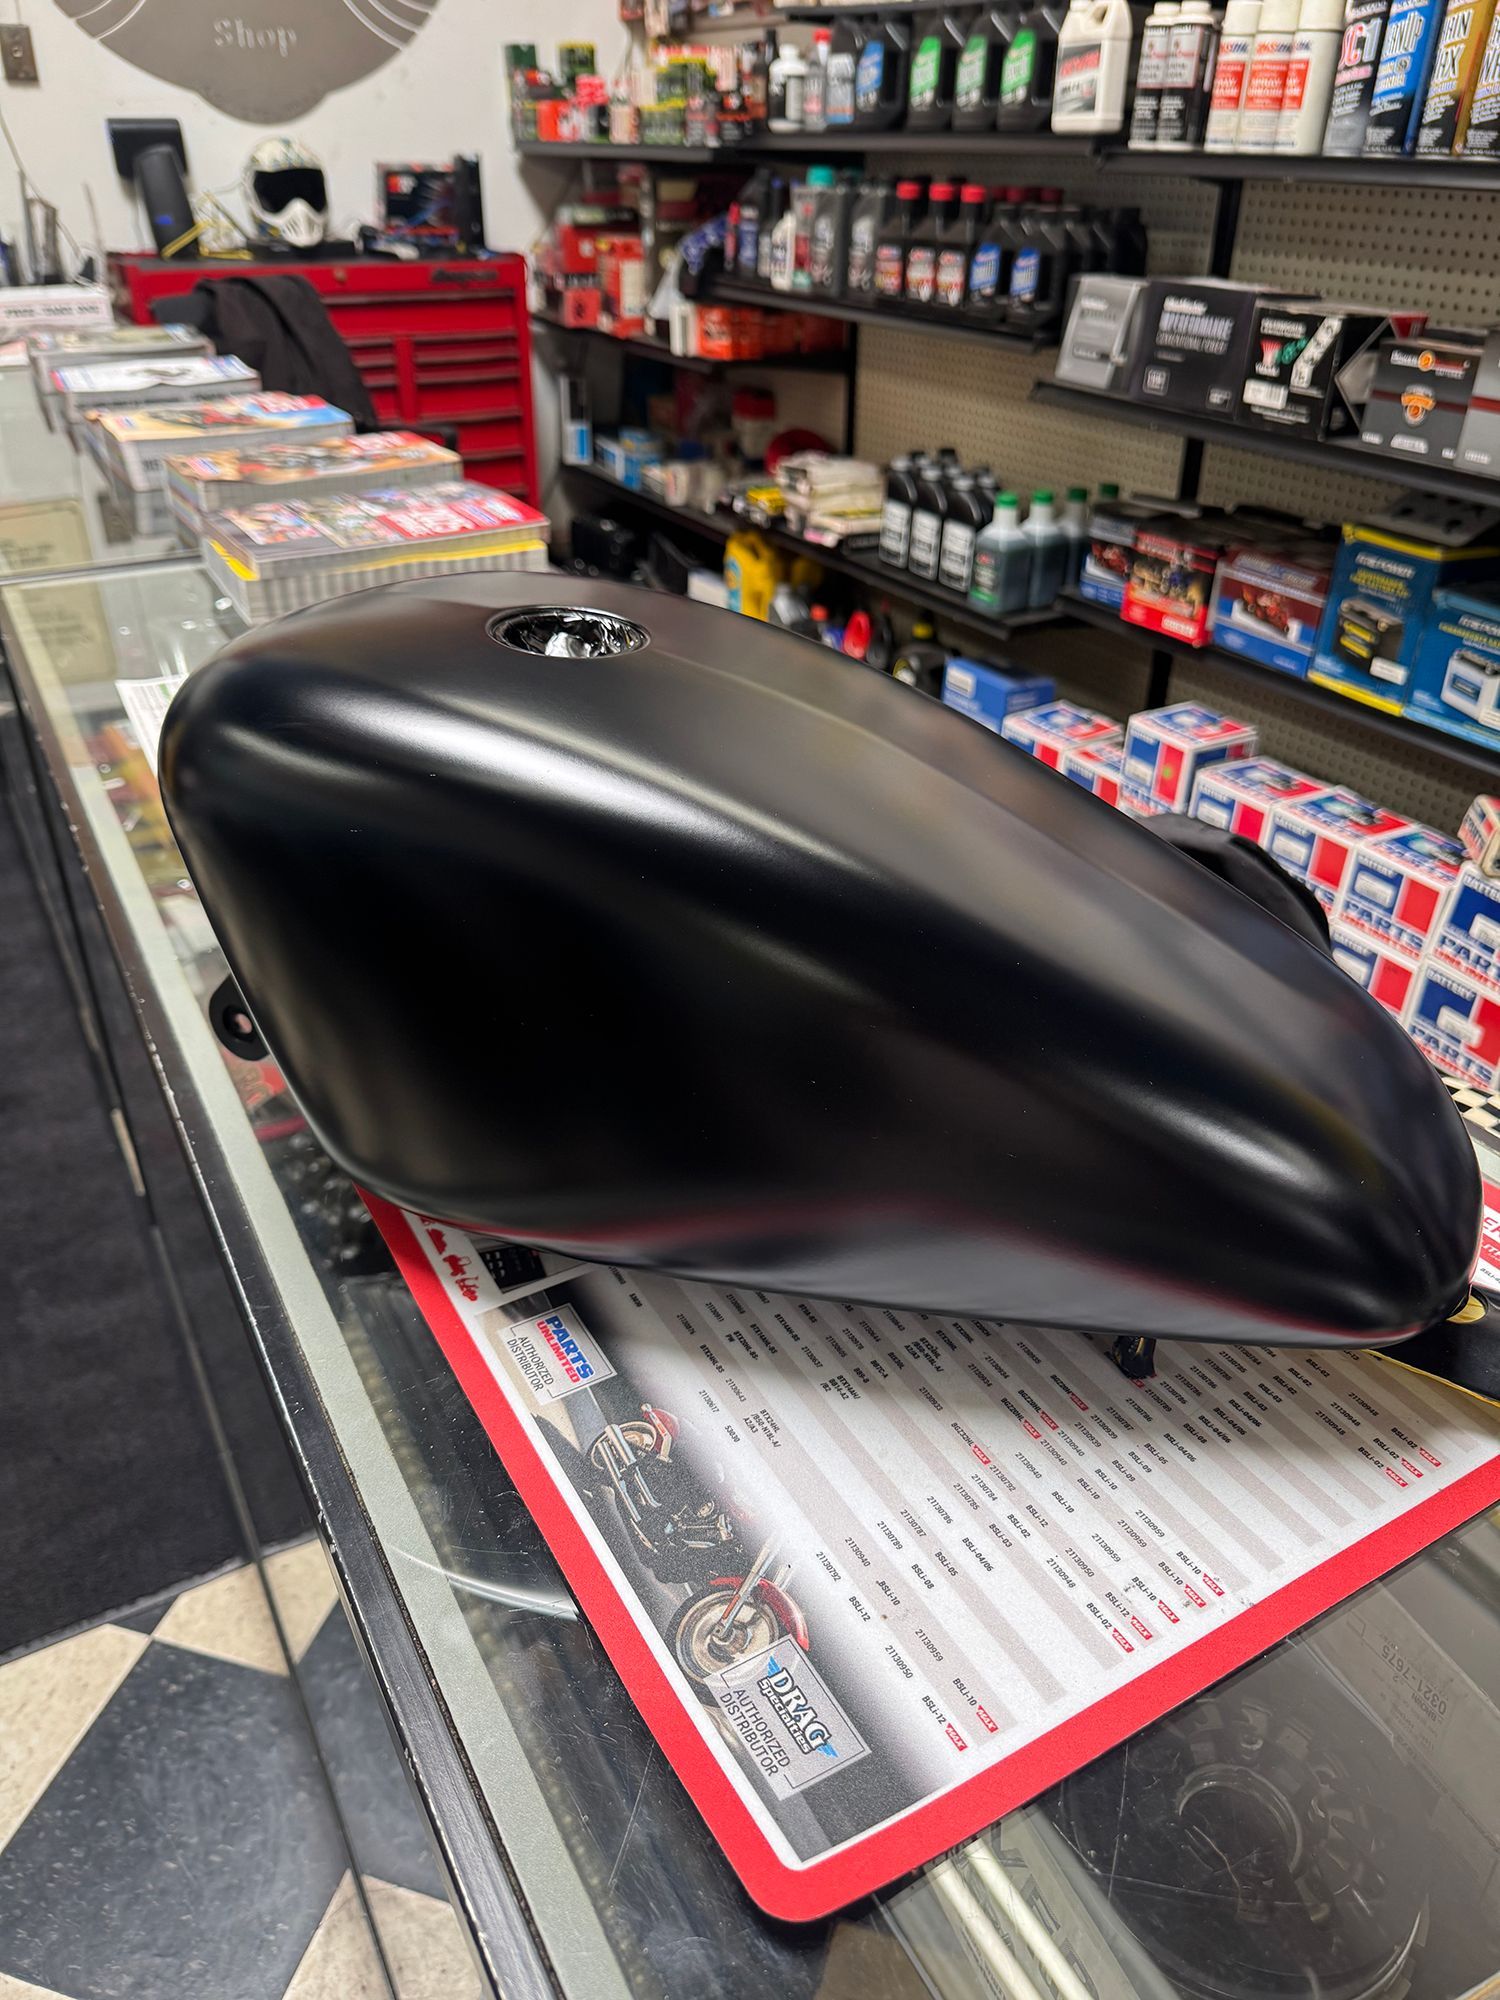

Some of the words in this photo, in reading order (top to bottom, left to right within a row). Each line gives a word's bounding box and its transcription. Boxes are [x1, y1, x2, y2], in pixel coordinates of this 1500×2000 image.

[213, 16, 298, 58] Shop
[1343, 901, 1424, 950] PARTS
[1426, 969, 1477, 1001] BATTERY
[1408, 1025, 1494, 1081] PARTS
[518, 1336, 555, 1386] AUTHORIZED
[536, 1320, 581, 1384] UNLIMITED
[544, 1315, 595, 1380] PARTS
[506, 1338, 546, 1393] DISTRIBUTOR
[1288, 1368, 1312, 1387] BSLi-02
[1258, 1383, 1283, 1403] BSLi-03
[1272, 1375, 1298, 1396] BSLi-02
[1001, 1398, 1024, 1422] BGZ20HL
[1229, 1399, 1262, 1428] BSLi-04/06
[1243, 1391, 1269, 1411] BSLi-03
[760, 1409, 780, 1433] BTX24HL
[1090, 1414, 1118, 1439] 21130939
[1106, 1407, 1135, 1430] 21130787
[1198, 1415, 1231, 1444] BSLi-04/06
[1213, 1407, 1247, 1438] BSLi-04/06
[725, 1425, 740, 1443] 53030
[951, 1423, 973, 1447] BGZ32HL
[1057, 1430, 1085, 1456] 21130940
[1074, 1422, 1102, 1448] 21130939
[1183, 1423, 1208, 1444] BSLi-08
[1391, 1427, 1417, 1449] BSLi-02
[1040, 1439, 1067, 1465] 21130940
[1144, 1443, 1168, 1465] BSLi-05
[1163, 1433, 1197, 1463] BSLi-04/06
[1358, 1446, 1384, 1469] BSLi-02
[1373, 1437, 1399, 1459] BSLi-02
[1015, 1452, 1042, 1479] 21130940
[1112, 1460, 1136, 1483] BSLi-09
[1128, 1451, 1152, 1473] BSLi-09
[972, 1474, 998, 1501] 21130784
[989, 1465, 1016, 1492] 21130792
[1077, 1478, 1100, 1500] BSLi-10
[1095, 1469, 1118, 1490] BSLi-10
[954, 1483, 980, 1510] 21130785
[1052, 1491, 1075, 1514] BSLi-10
[900, 1509, 927, 1537] 21130787
[927, 1496, 953, 1525] 21130786
[1026, 1505, 1048, 1528] BSLi-12
[1135, 1510, 1165, 1537] 21130959
[877, 1521, 903, 1550] 21130789
[989, 1524, 1013, 1548] BSLi-03
[1007, 1514, 1031, 1539] BSLi-02
[1117, 1520, 1147, 1548] 21130959
[845, 1537, 871, 1567] 21130940
[962, 1537, 994, 1572] BSLi-04/06
[1092, 1534, 1122, 1562] 21130959
[816, 1552, 841, 1581] 21130792
[935, 1549, 958, 1577] BSLi-05
[1047, 1558, 1076, 1588] 21130948
[1065, 1548, 1095, 1577] 21130950
[1158, 1562, 1183, 1586] BSLi-10
[1177, 1551, 1202, 1575] BSLi-10
[912, 1563, 935, 1590] BSLi-08
[1132, 1577, 1157, 1601] BSLi-10
[878, 1581, 901, 1606] BSLi-10
[1105, 1592, 1130, 1617] BSLi-12
[849, 1596, 871, 1622] BSLi-12
[1087, 1603, 1112, 1629] BSLi-02
[915, 1629, 944, 1662] 21130959
[885, 1645, 914, 1679] 21130950
[952, 1678, 978, 1707] BSLi-10
[1381, 1644, 1447, 1715] 0321-7675
[757, 1675, 813, 1756] Specialties
[769, 1667, 833, 1750] DRAG
[921, 1695, 947, 1725] BSLi-12
[719, 1692, 780, 1777] DISTRIBUTOR
[733, 1687, 791, 1768] AUTHORIZED
